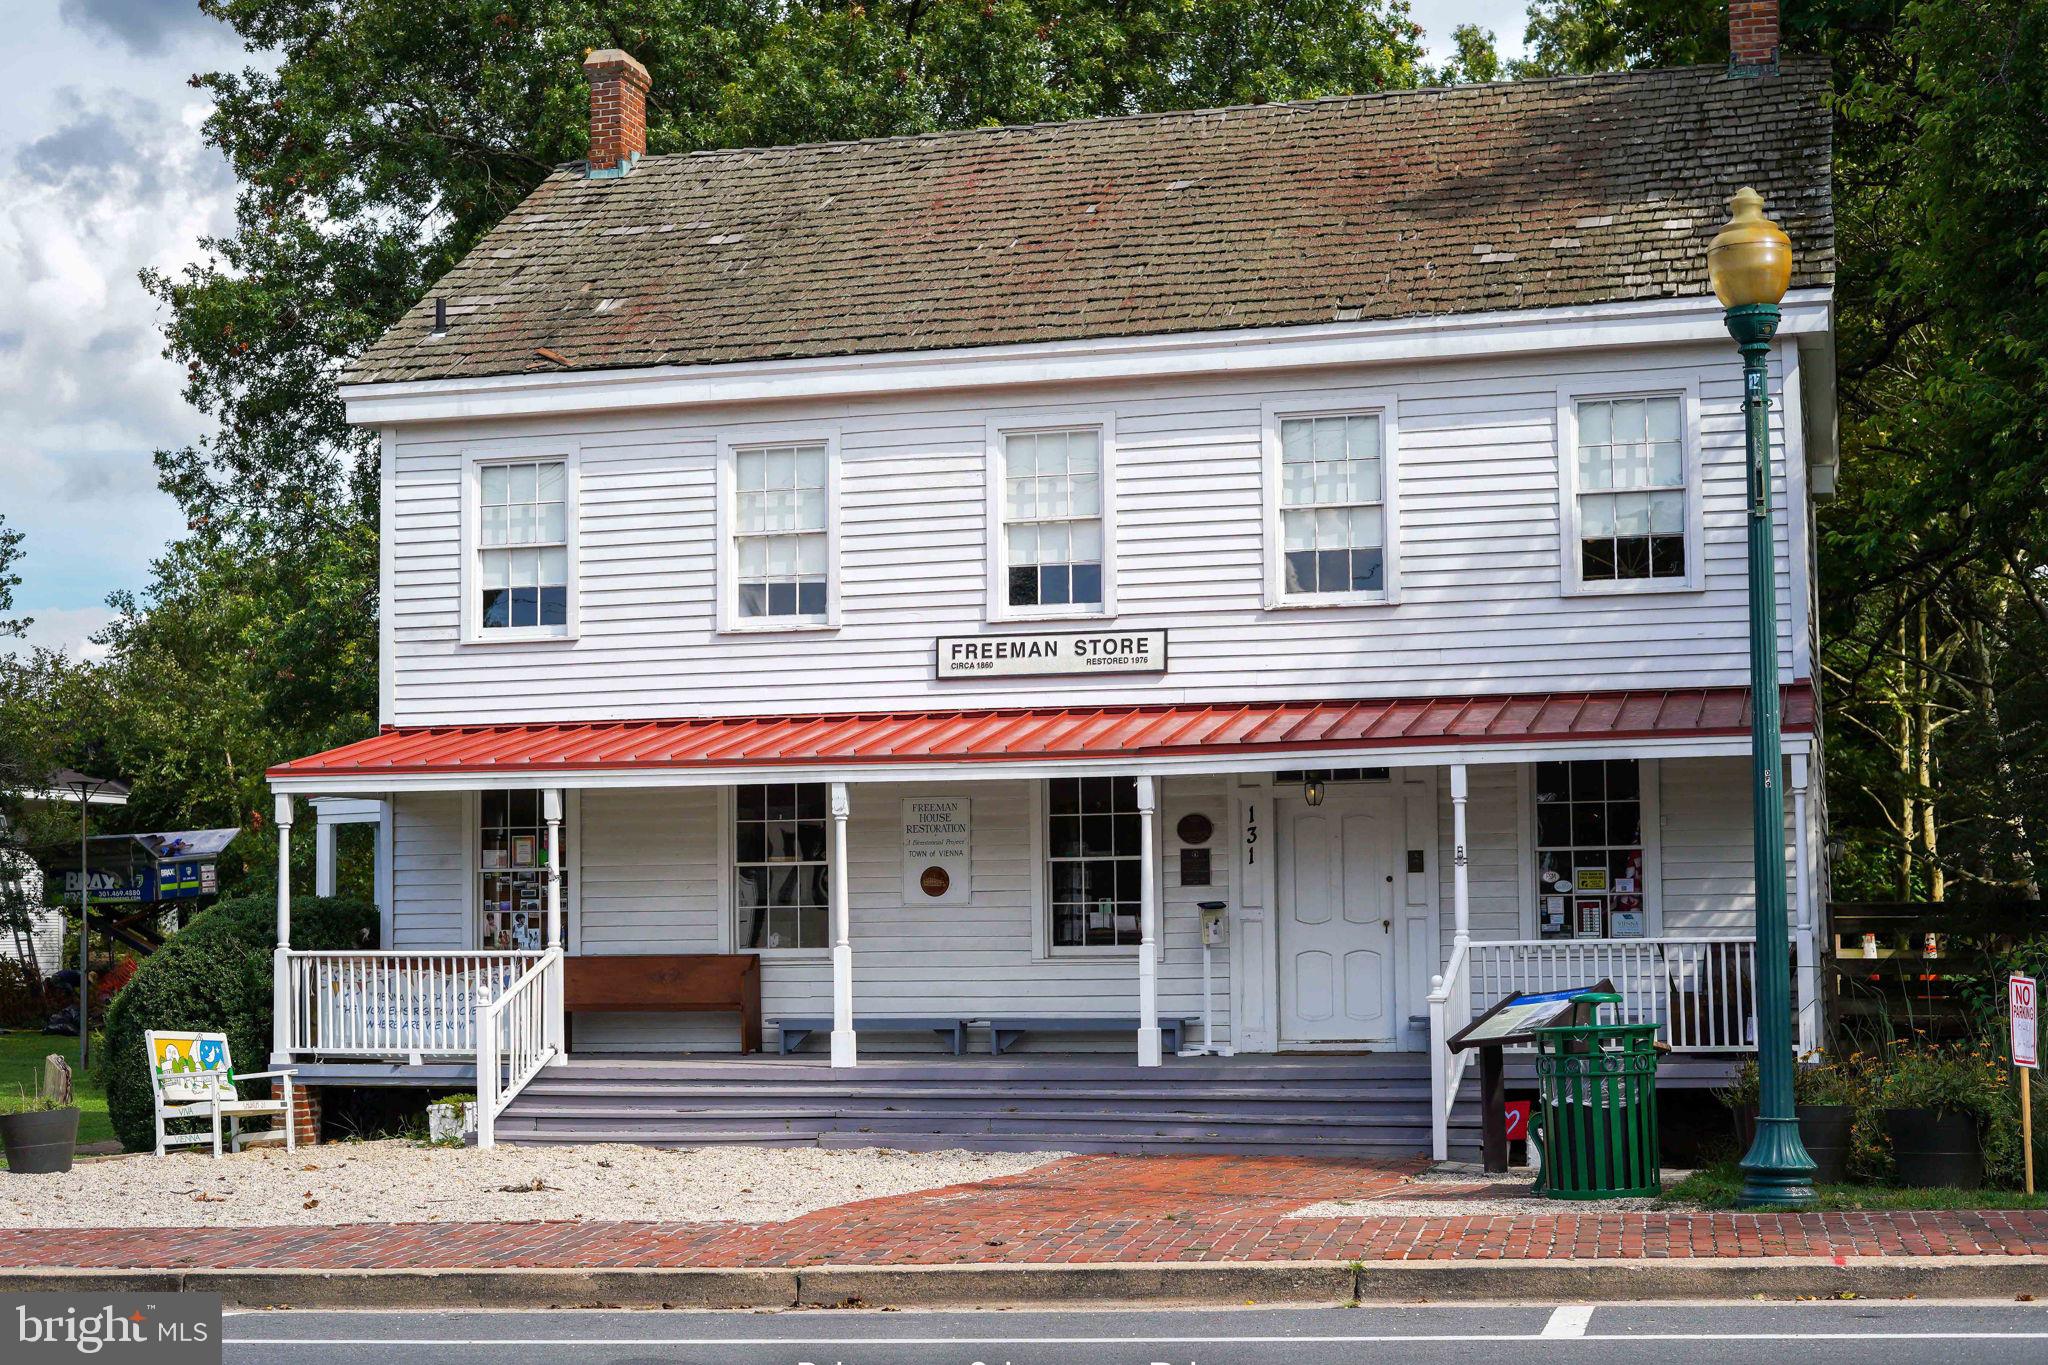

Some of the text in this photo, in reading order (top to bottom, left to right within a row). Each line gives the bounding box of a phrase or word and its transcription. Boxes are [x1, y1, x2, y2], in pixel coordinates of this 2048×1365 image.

[951, 638, 1149, 660] FREEMAN STORE
[951, 661, 994, 670] CIRCA 1860
[1086, 656, 1148, 666] RESTORED 1976
[912, 803, 958, 813] FREEMAN
[919, 813, 952, 823] HOUSE
[906, 824, 967, 834] RESTORATION
[945, 839, 965, 847] Project
[909, 850, 927, 858] TOWN
[939, 849, 964, 857] VIENNA
[65, 871, 115, 891] BRAX
[2015, 984, 2031, 1006] NO
[2013, 1005, 2034, 1020] PARKING
[178, 1108, 194, 1116] VIVA
[174, 1134, 202, 1143] VIENNA
